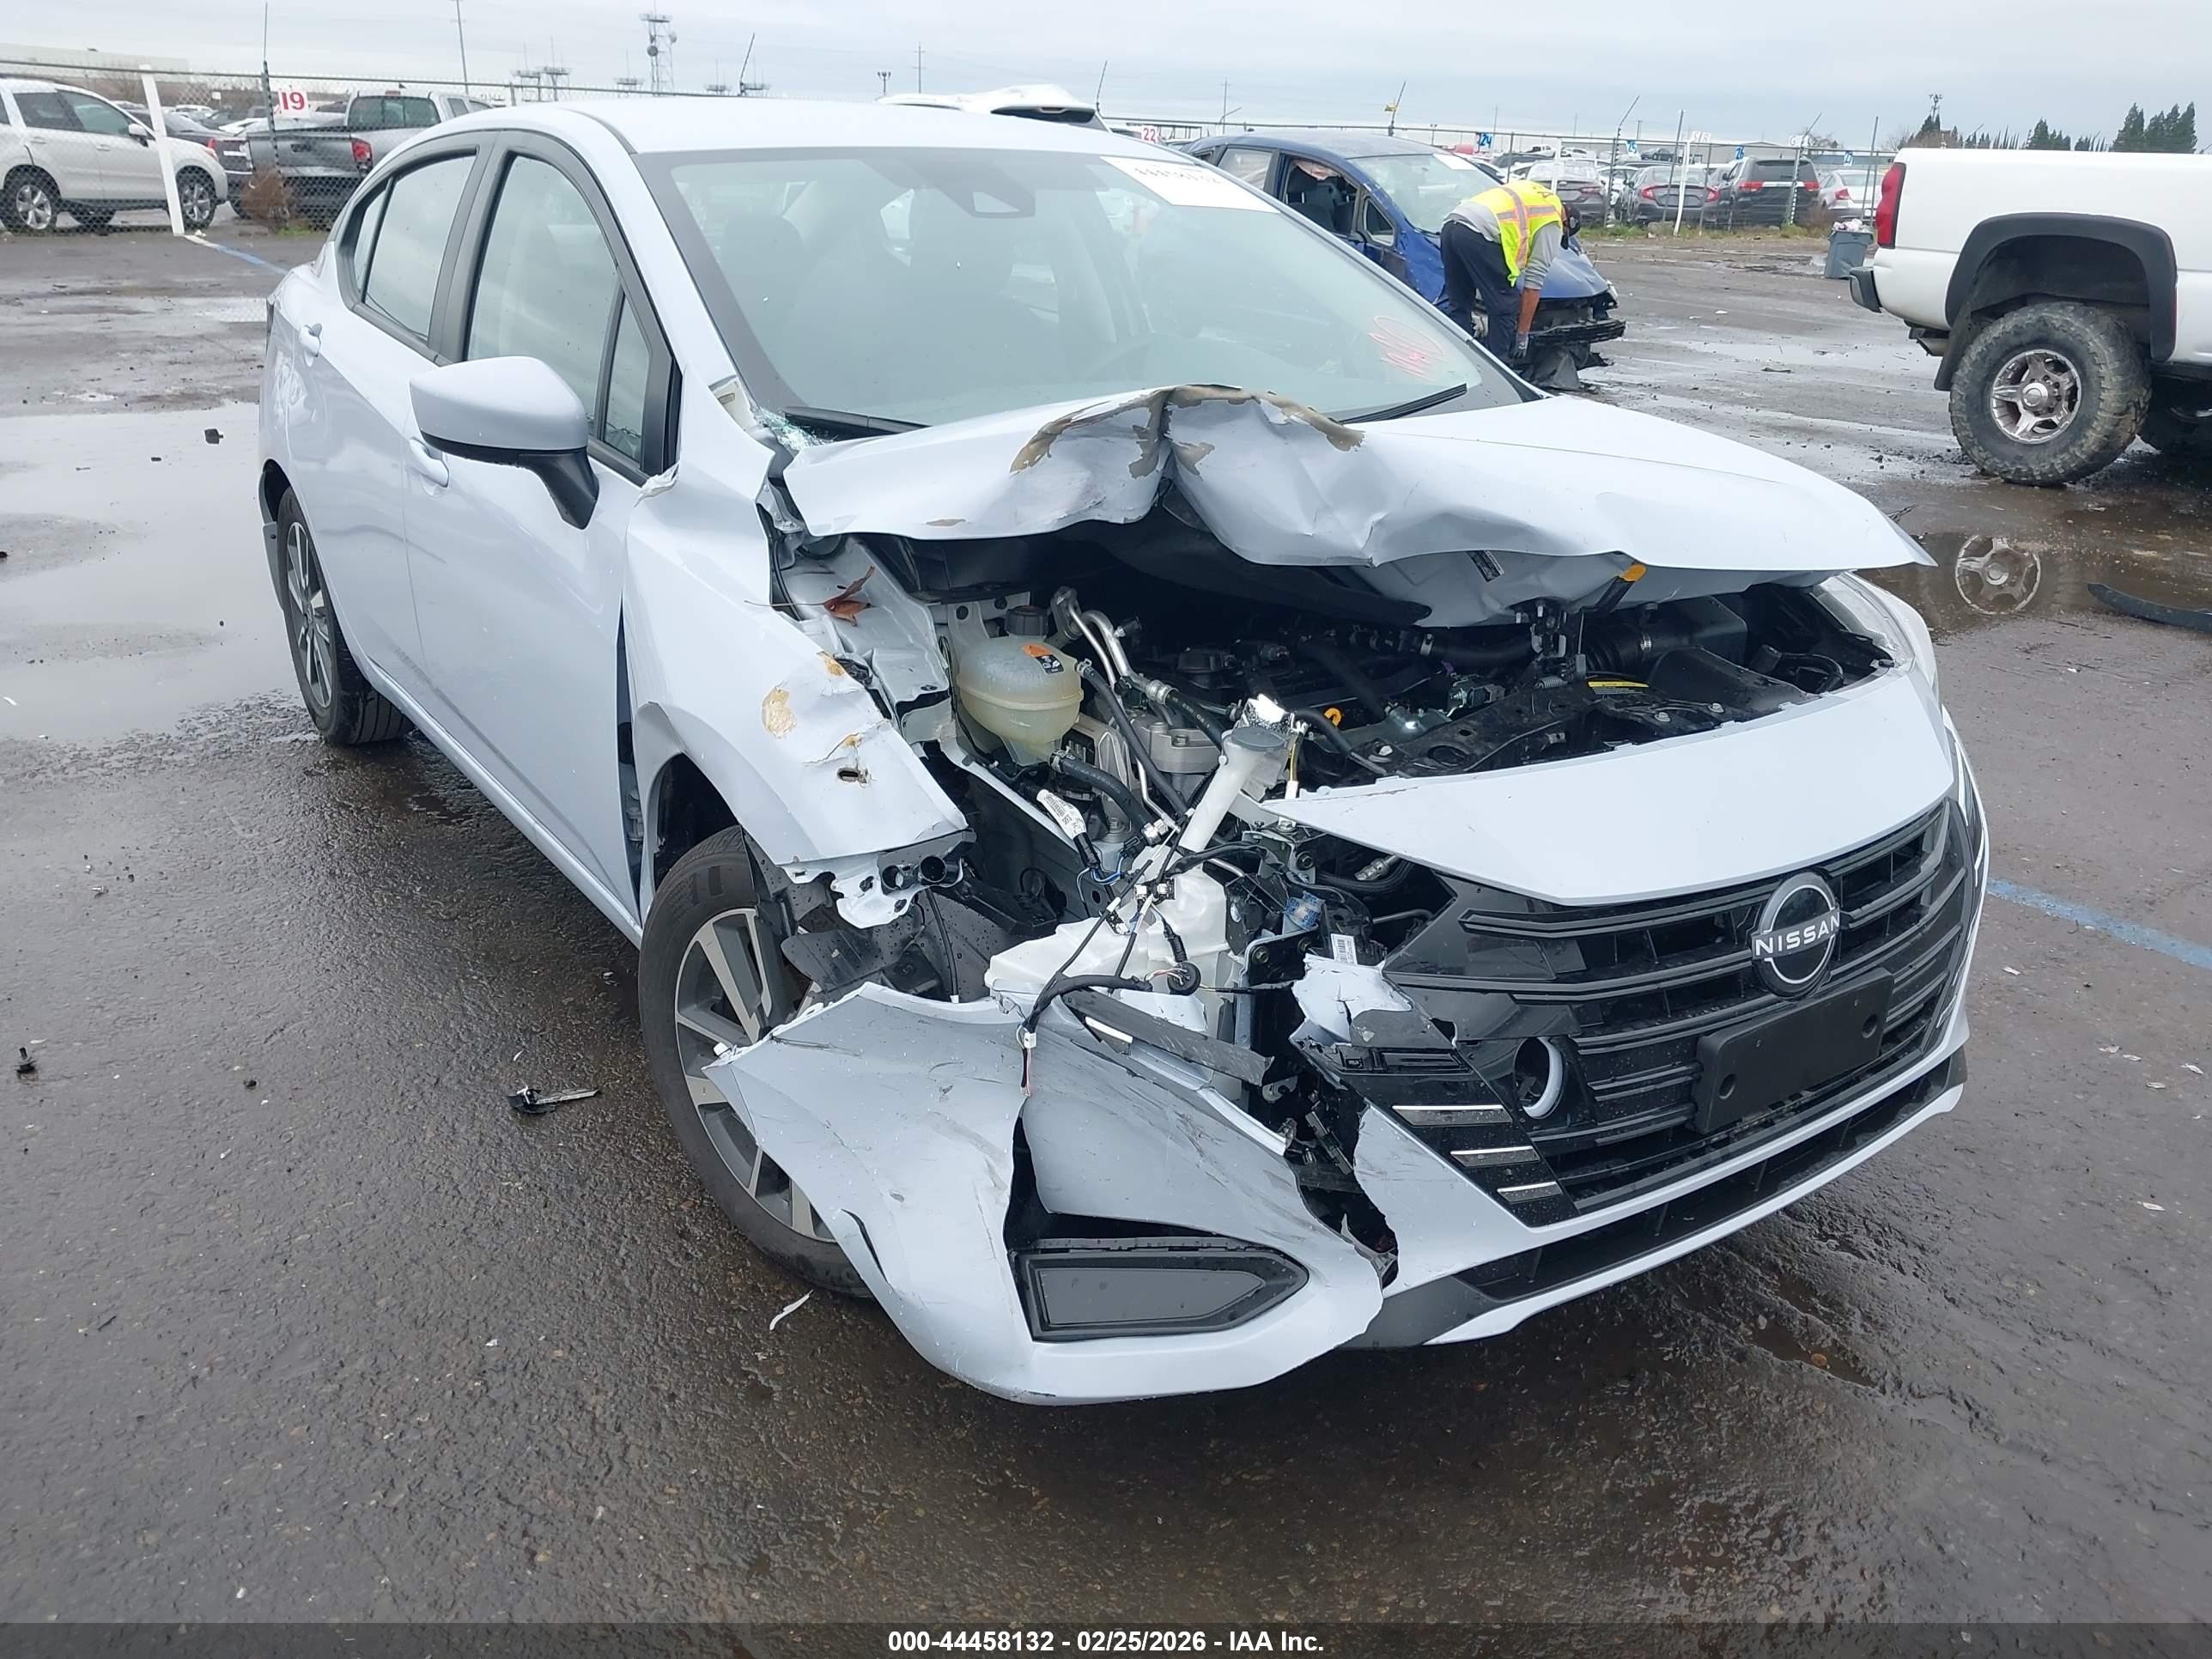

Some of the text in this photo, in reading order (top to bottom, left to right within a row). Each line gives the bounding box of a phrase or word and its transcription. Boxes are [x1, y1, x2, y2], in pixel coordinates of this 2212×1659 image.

[282, 92, 305, 110] 19
[1143, 128, 1156, 142] 22
[1480, 133, 1492, 149] 24
[1755, 911, 1840, 956] NISSAN
